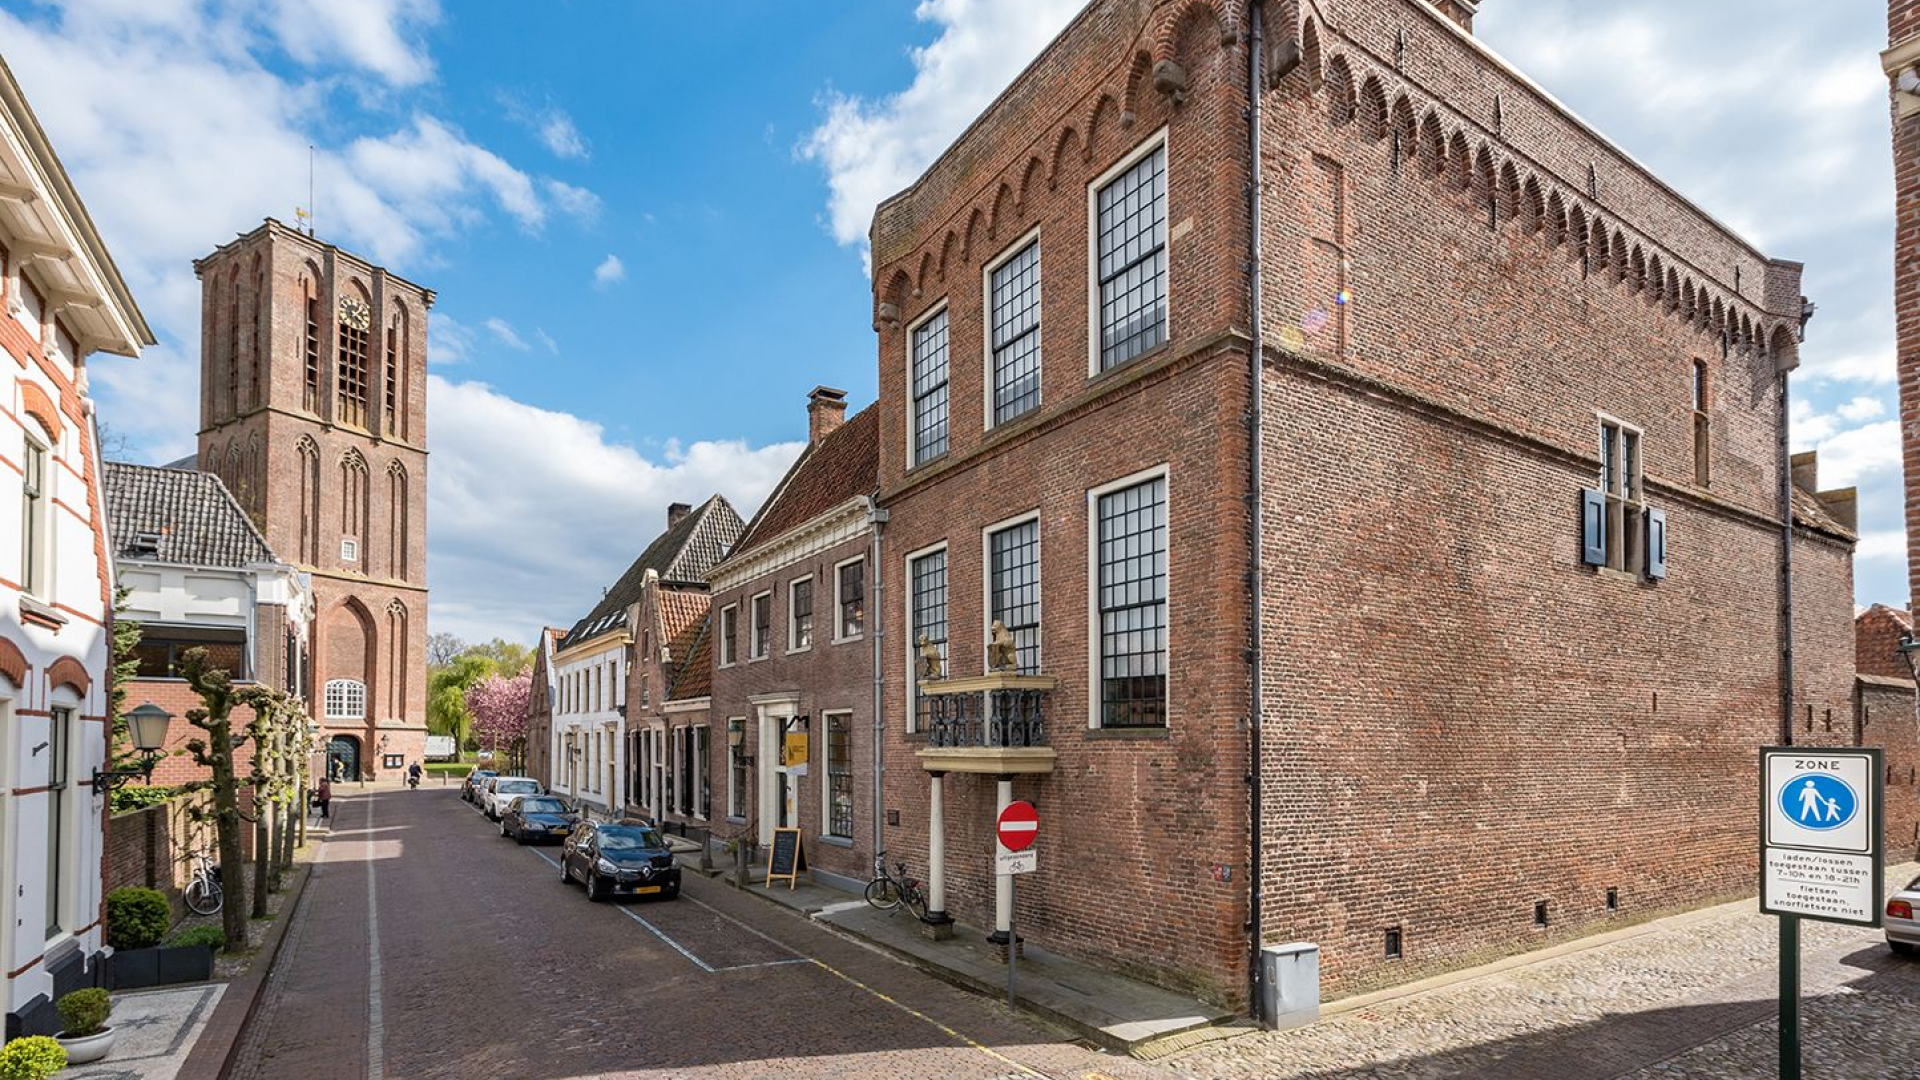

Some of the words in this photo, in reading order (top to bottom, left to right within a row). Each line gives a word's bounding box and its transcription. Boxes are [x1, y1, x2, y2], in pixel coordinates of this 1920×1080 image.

[1795, 760, 1840, 770] ZONE
[1782, 853, 1853, 866] laden/lossen
[1769, 860, 1827, 871] toegestaan
[1831, 867, 1868, 876] tussen
[1776, 869, 1805, 878] 7-10h
[1800, 885, 1838, 895] fietsen
[1774, 899, 1838, 912] snorfietsers
[1841, 907, 1864, 916] niet
